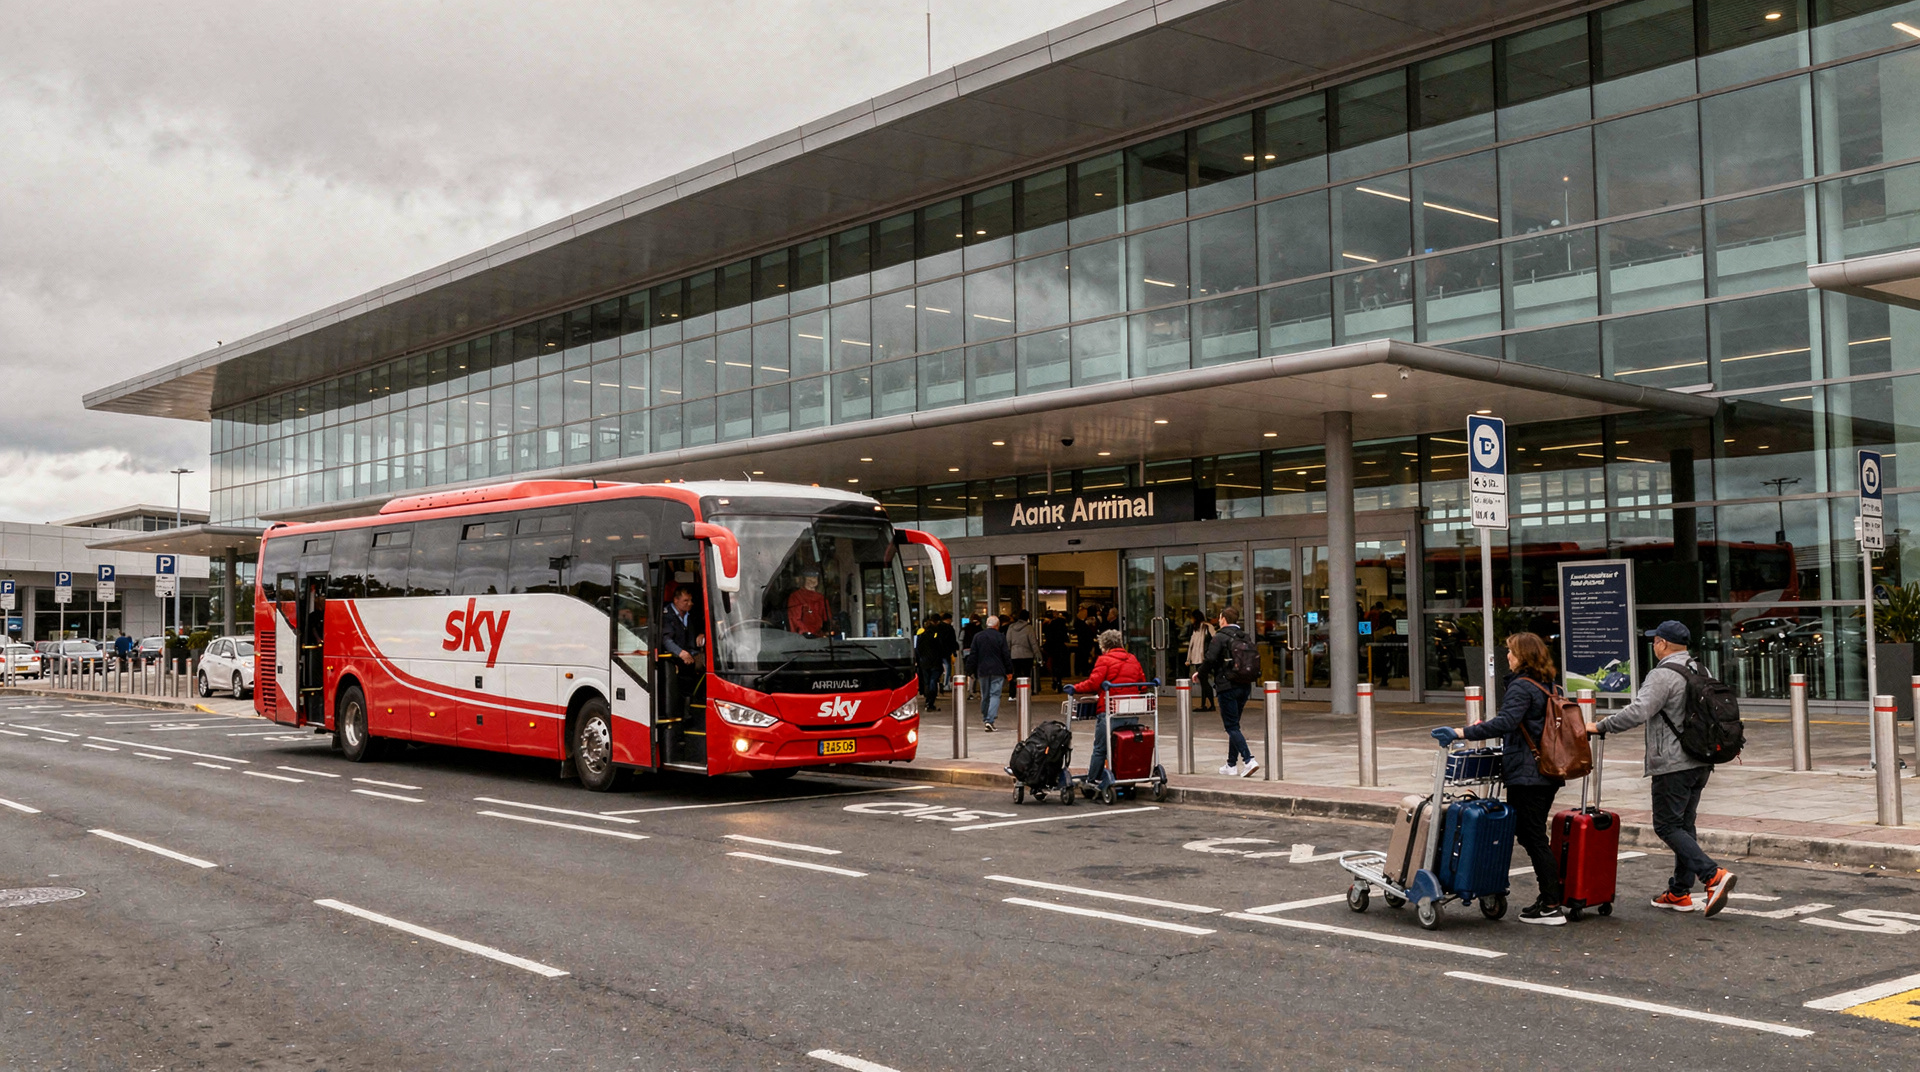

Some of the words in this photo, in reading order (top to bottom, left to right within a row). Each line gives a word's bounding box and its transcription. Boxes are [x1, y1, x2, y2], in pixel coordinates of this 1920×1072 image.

[160, 557, 171, 572] P
[58, 572, 69, 585] P
[101, 567, 112, 579] P
[4, 582, 12, 594] P
[442, 597, 511, 668] sky
[811, 679, 860, 690] ARRIVALS
[817, 696, 861, 721] sky
